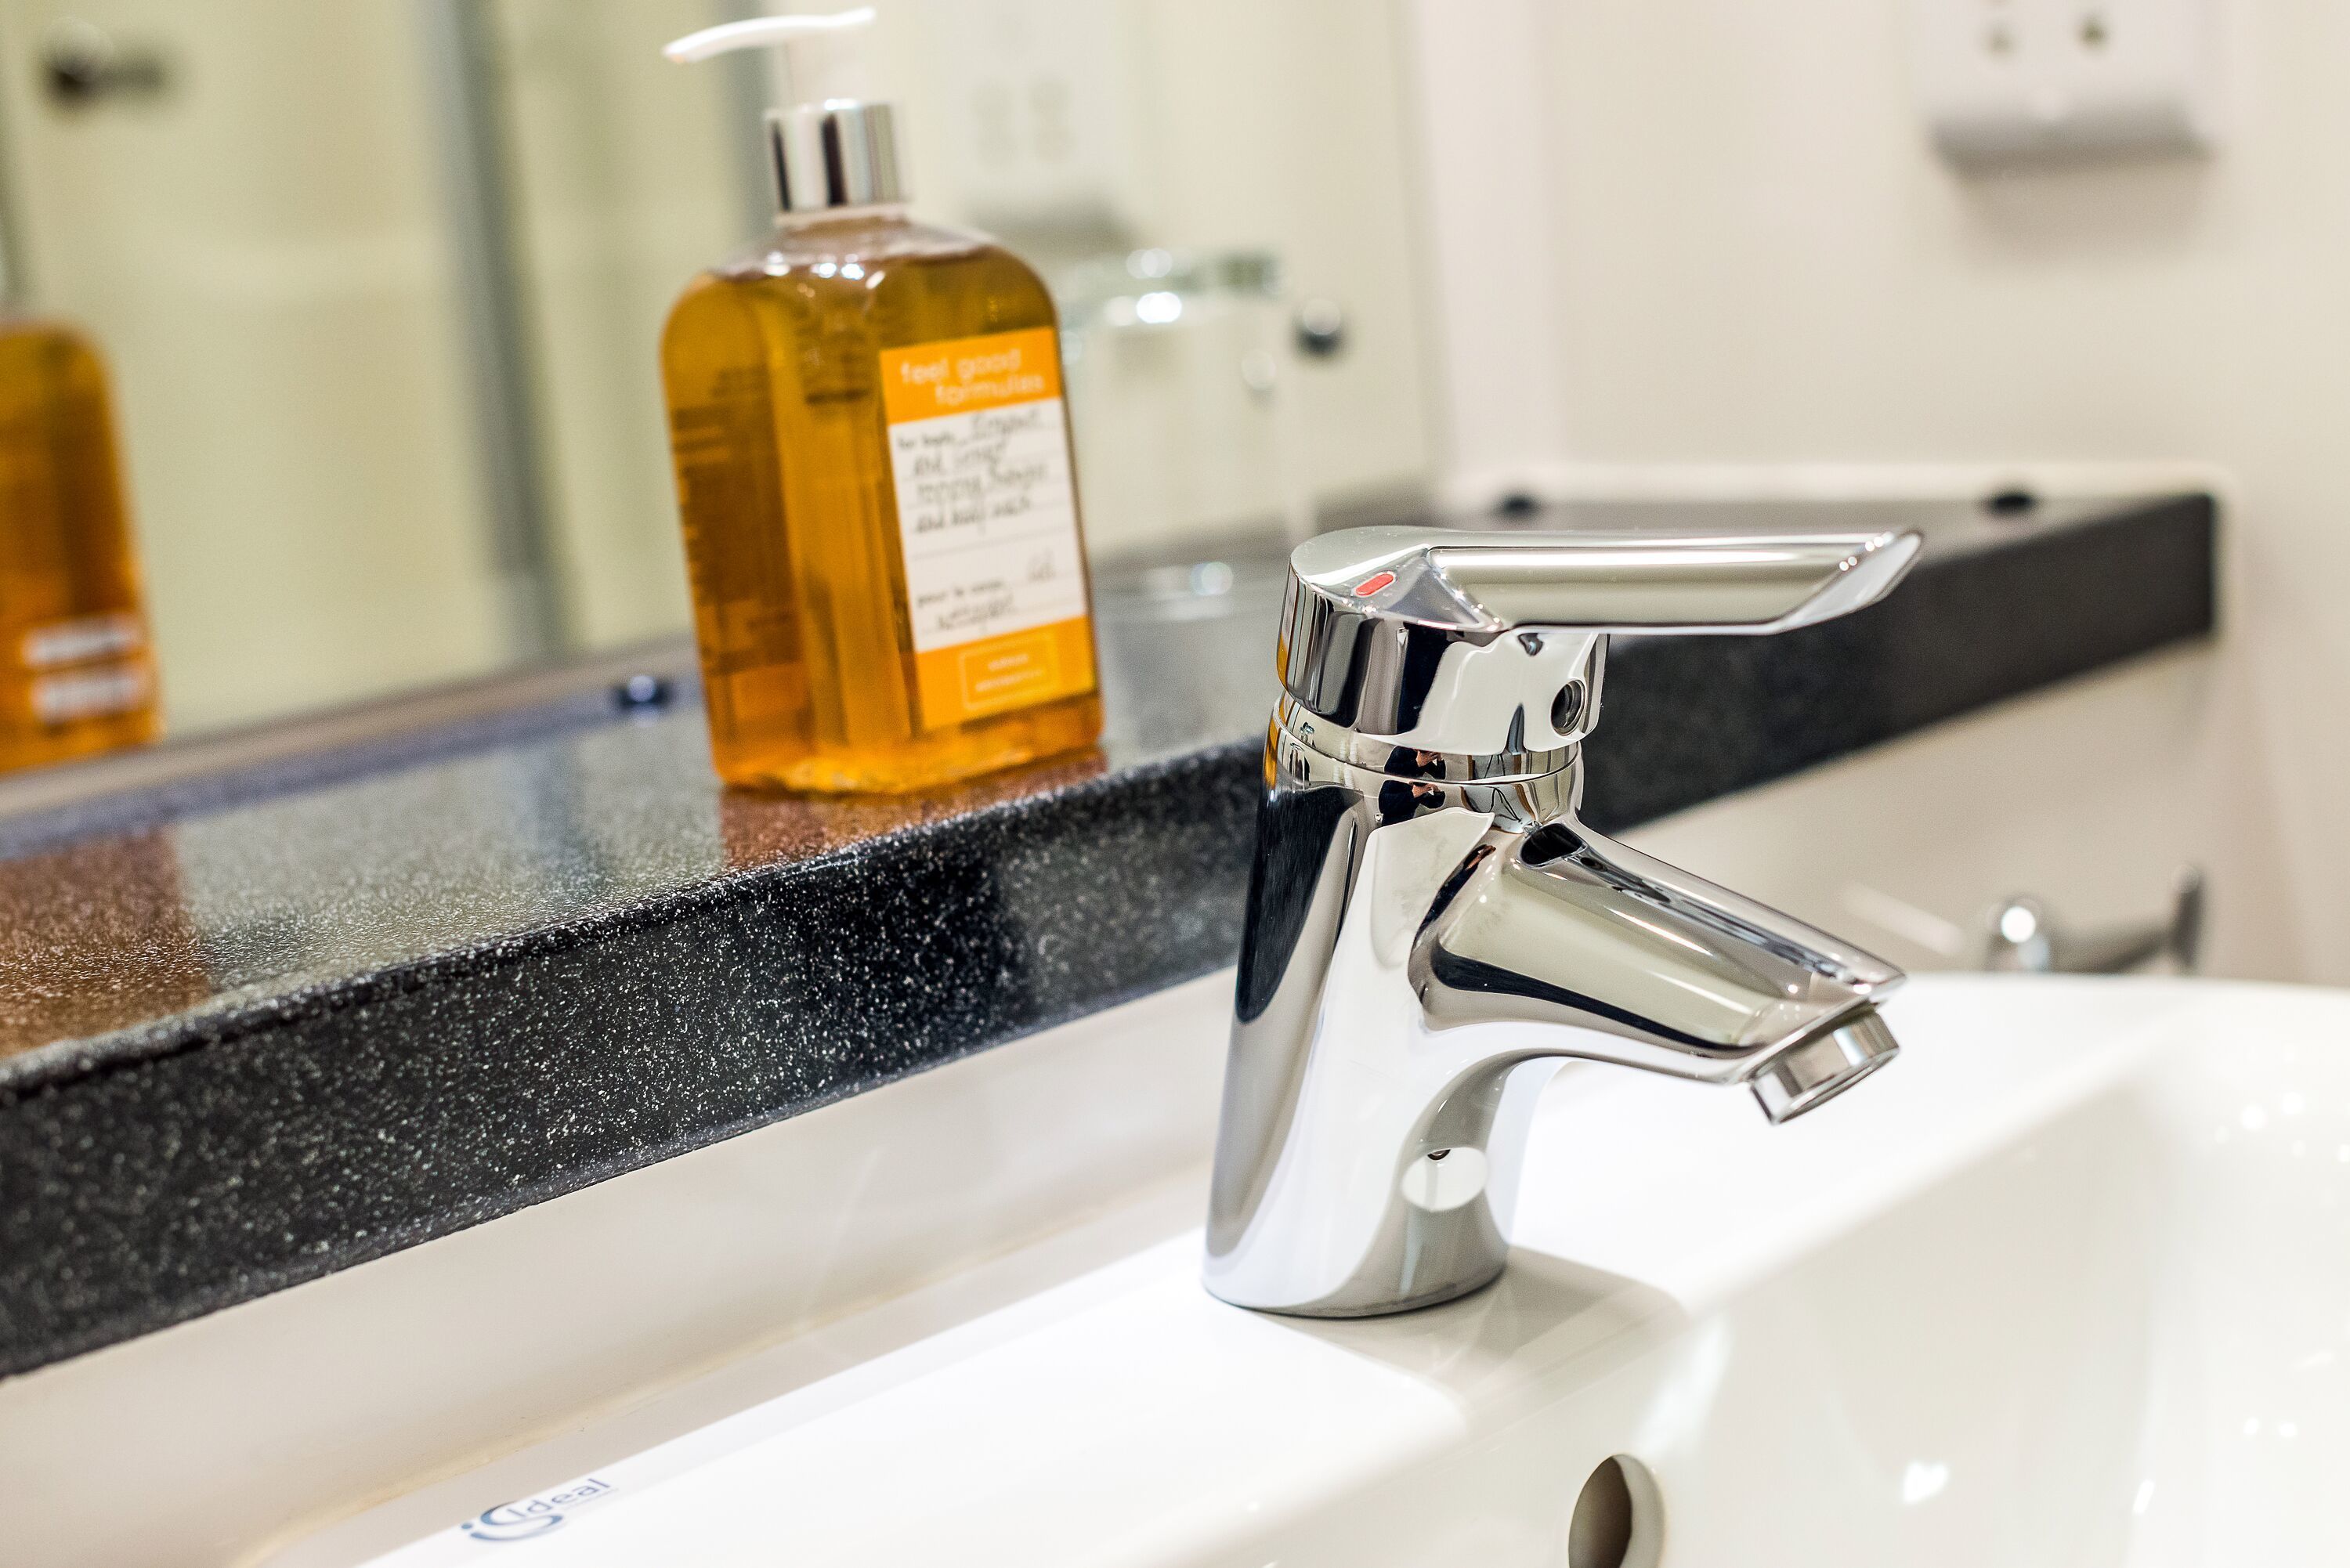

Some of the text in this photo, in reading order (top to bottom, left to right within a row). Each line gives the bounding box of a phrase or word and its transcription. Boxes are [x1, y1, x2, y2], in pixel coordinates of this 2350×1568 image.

[900, 349, 1021, 385] feel good
[507, 1478, 610, 1517] Ideal
